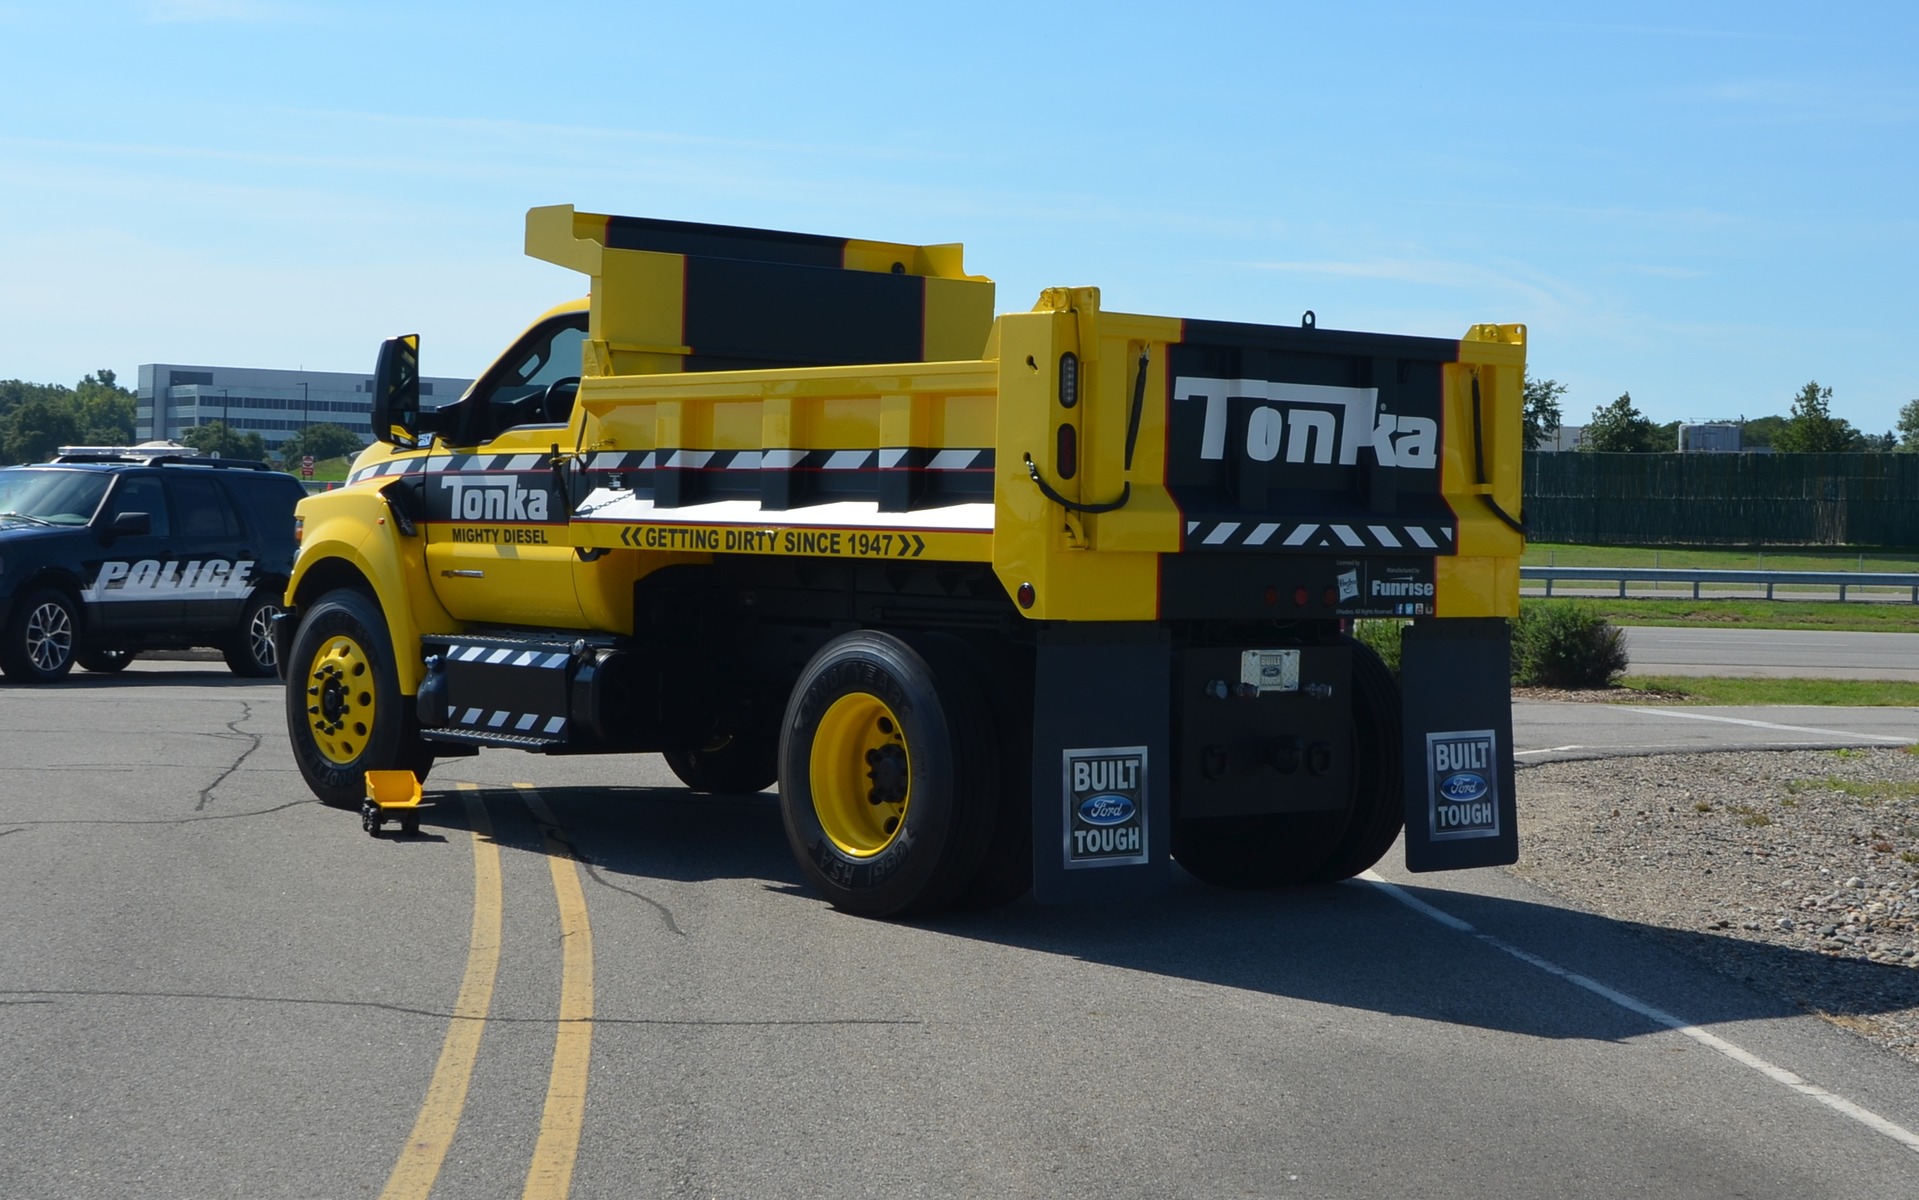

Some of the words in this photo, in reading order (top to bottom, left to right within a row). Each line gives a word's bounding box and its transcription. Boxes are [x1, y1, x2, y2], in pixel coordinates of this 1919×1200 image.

[1174, 376, 1437, 469] Tonka
[441, 475, 548, 520] Tonka
[452, 528, 499, 543] MIGHTY
[503, 529, 548, 544] DIESEL
[645, 527, 720, 549] GETTING
[727, 530, 779, 551] DIRTY
[784, 531, 841, 554] SINCE
[847, 533, 893, 556] 1947
[92, 559, 255, 591] POLICE
[1372, 580, 1433, 595] Funrise
[1261, 656, 1280, 666] BUILT
[1435, 742, 1488, 771] BUILT
[1074, 760, 1139, 792] BUILT
[1450, 777, 1478, 794] Ford
[1090, 799, 1123, 817] Ford
[1438, 803, 1492, 827] TOUGH
[1074, 827, 1139, 853] TOUGH
